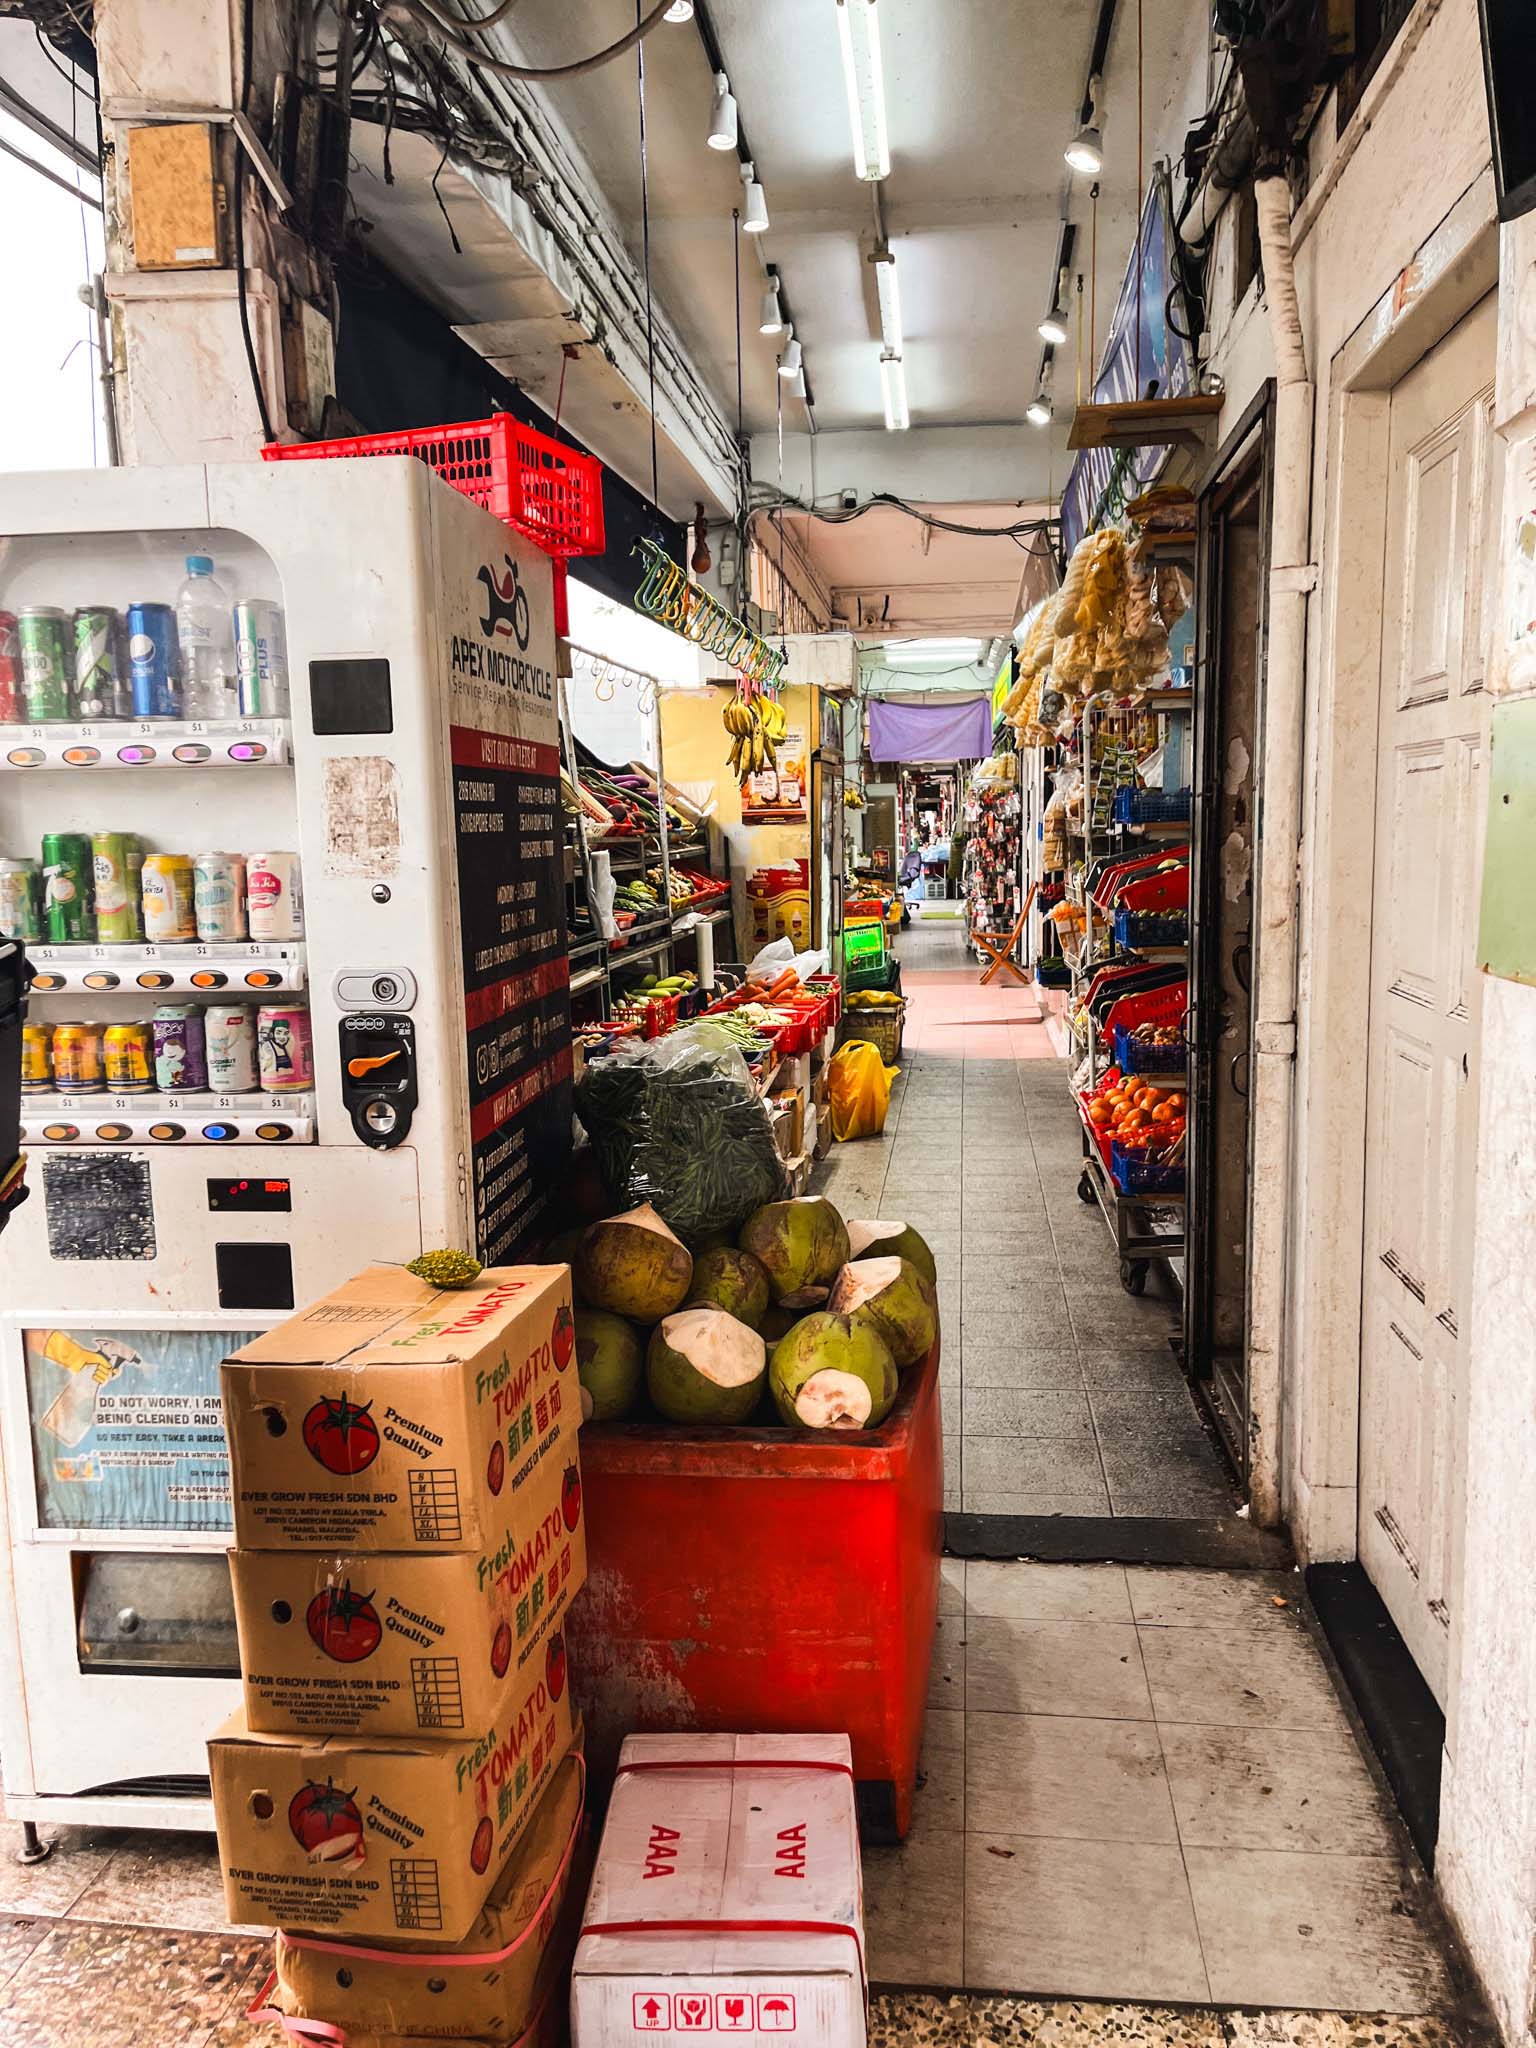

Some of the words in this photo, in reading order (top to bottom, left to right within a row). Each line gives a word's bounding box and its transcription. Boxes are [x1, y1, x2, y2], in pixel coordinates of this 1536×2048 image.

[257, 638, 269, 679] PLUS
[452, 635, 485, 680] APEX
[487, 648, 552, 701] MOTORCYCLE
[32, 729, 42, 737] $1
[82, 728, 92, 736] $1
[141, 724, 151, 732] $1
[192, 723, 202, 731] $1
[243, 723, 252, 731] $1
[146, 947, 156, 955] $1
[197, 947, 207, 955] $1
[250, 946, 260, 954] $1
[220, 1098, 230, 1106] $1
[271, 1099, 281, 1107] $1
[437, 1282, 526, 1338] TOMATO
[392, 1322, 448, 1347] Fresh
[475, 1350, 511, 1404] Fresh
[492, 1341, 551, 1427] TOMATO
[100, 1398, 114, 1407] DO
[120, 1398, 143, 1408] NOT
[97, 1414, 132, 1424] BEING
[137, 1415, 189, 1425] CLEANED
[194, 1415, 218, 1425] AND
[384, 1407, 444, 1447] Premium
[383, 1427, 432, 1459] Quality
[241, 1492, 268, 1501] EVER
[271, 1492, 306, 1501] GROW
[309, 1493, 344, 1502] FRESH
[347, 1493, 370, 1502] SDN
[374, 1494, 398, 1503] BHD
[477, 1529, 515, 1593] Fresh
[385, 1597, 445, 1637] Premium
[385, 1616, 435, 1649] Quality
[248, 1675, 273, 1686] EVER
[276, 1677, 311, 1687] GROW
[313, 1678, 347, 1688] FRESH
[350, 1679, 373, 1689] SDN
[376, 1680, 400, 1690] BHD
[476, 1680, 547, 1811] TOMATO
[456, 1728, 496, 1793] Fresh
[367, 1795, 424, 1838] Premium
[366, 1815, 414, 1850] Quality
[642, 1823, 680, 1880] AAA
[774, 1822, 807, 1879] AAA
[229, 1868, 254, 1881] EVER
[257, 1872, 290, 1884] GROW
[292, 1875, 326, 1887] FRESH
[329, 1878, 352, 1889] SDN
[355, 1880, 380, 1890] BHD
[645, 2019, 660, 2028] UP
